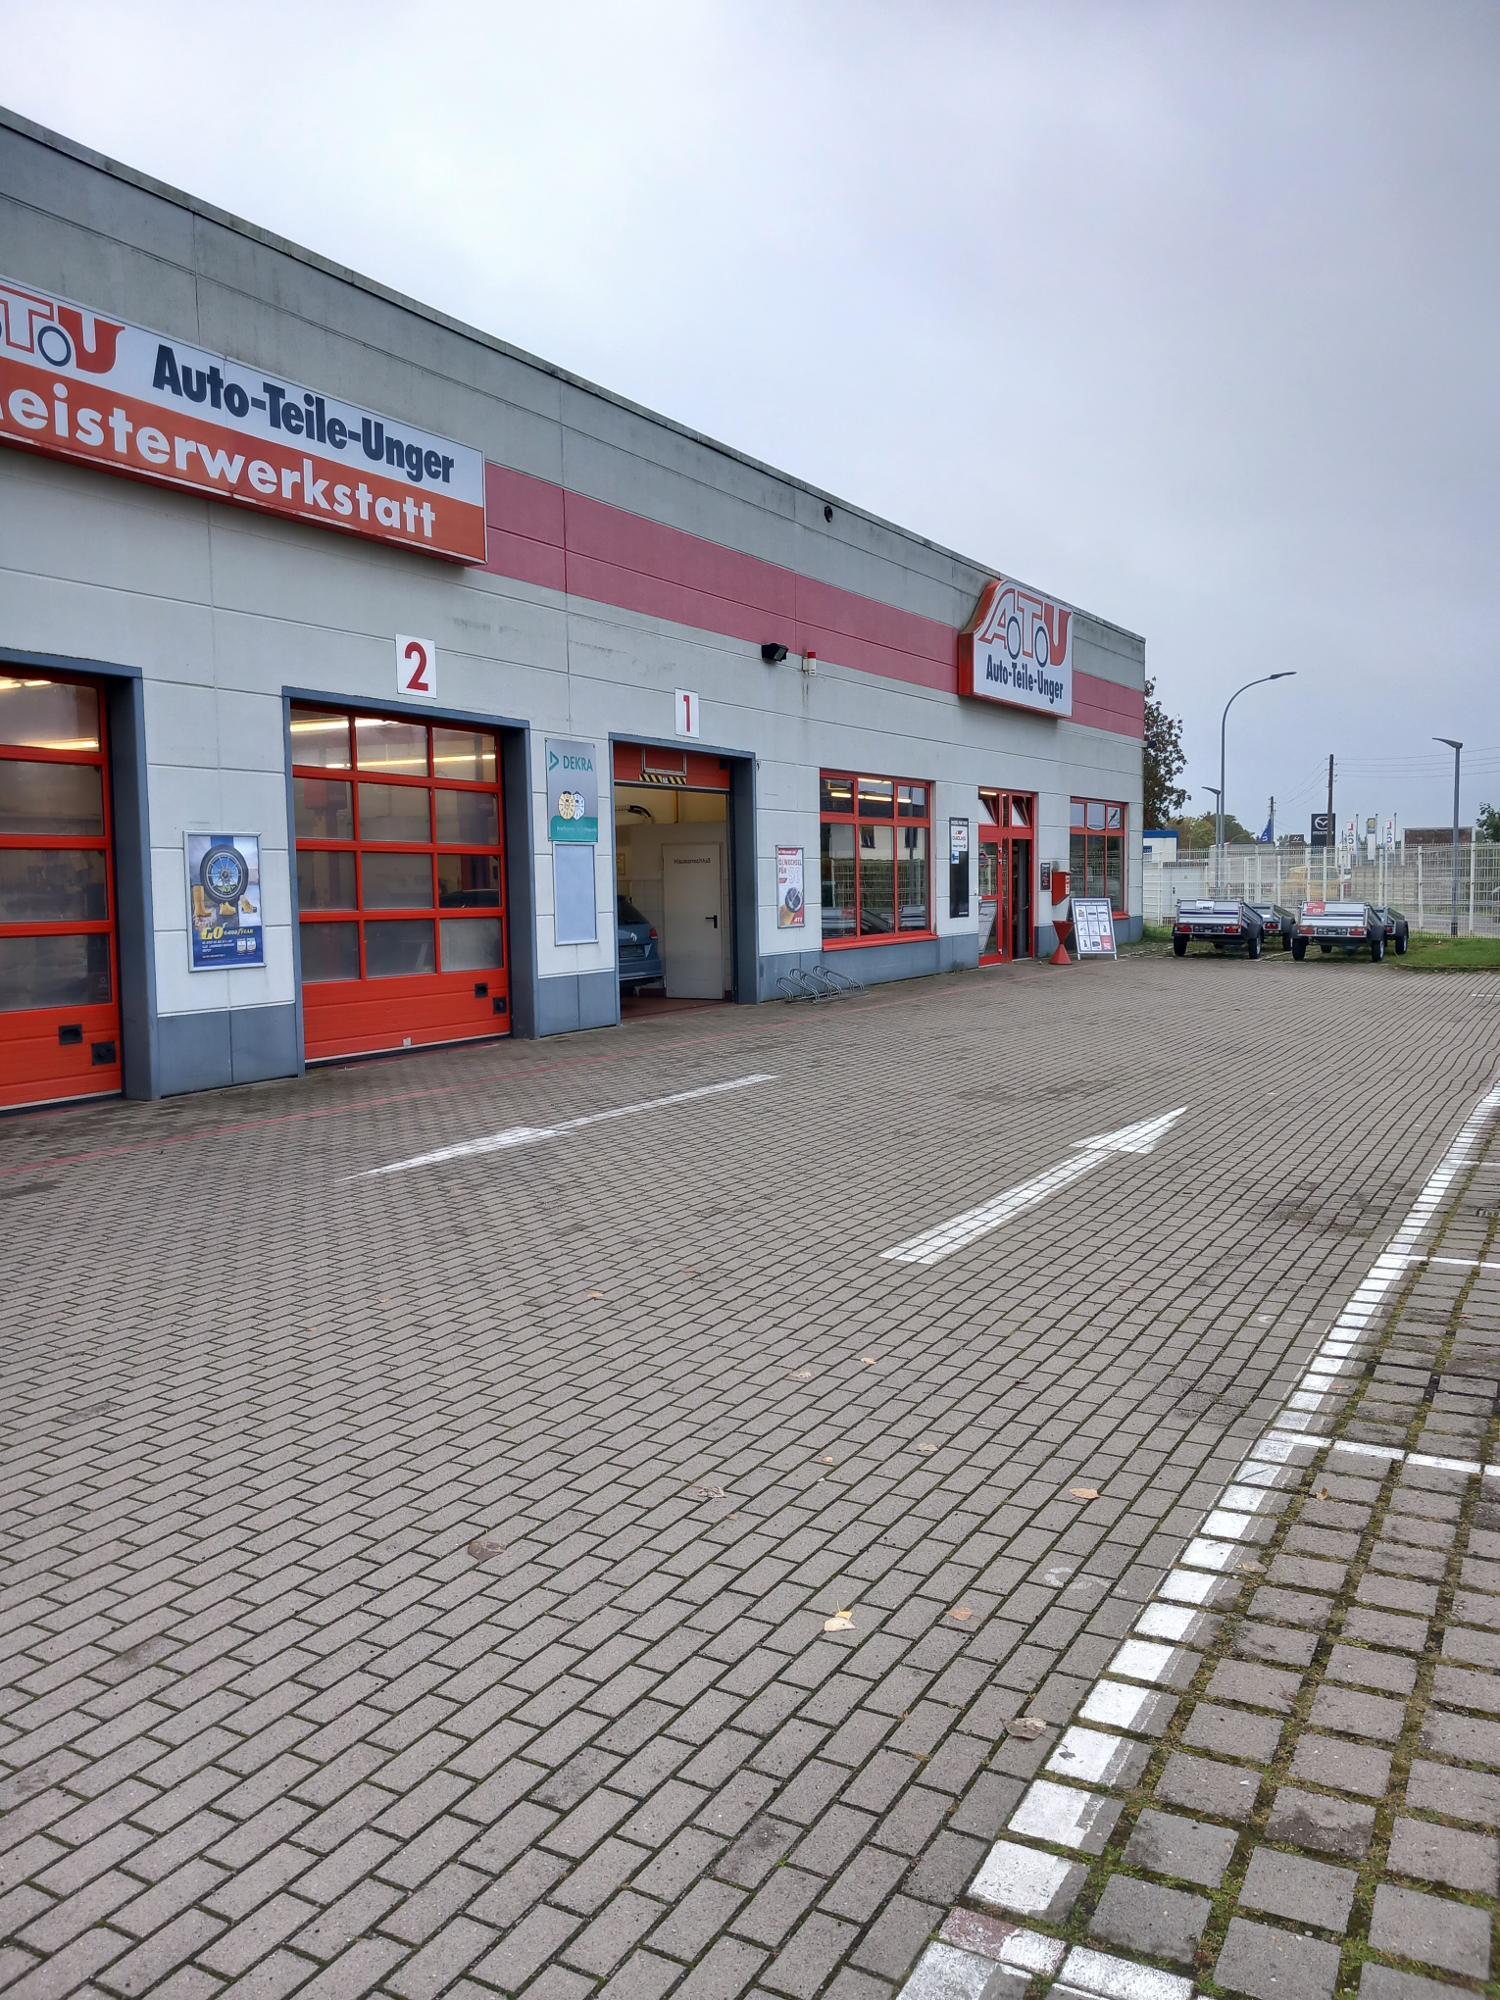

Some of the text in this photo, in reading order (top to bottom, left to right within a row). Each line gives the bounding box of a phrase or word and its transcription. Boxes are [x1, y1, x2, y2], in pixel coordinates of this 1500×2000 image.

[0, 284, 455, 484] TU Auto-Teile-Unger
[0, 382, 436, 538] eisterwerkstatt
[404, 641, 429, 692] 2
[986, 654, 1064, 705] Auto-Teile-Unger
[683, 694, 691, 732] 1
[563, 755, 593, 772] DEKRA
